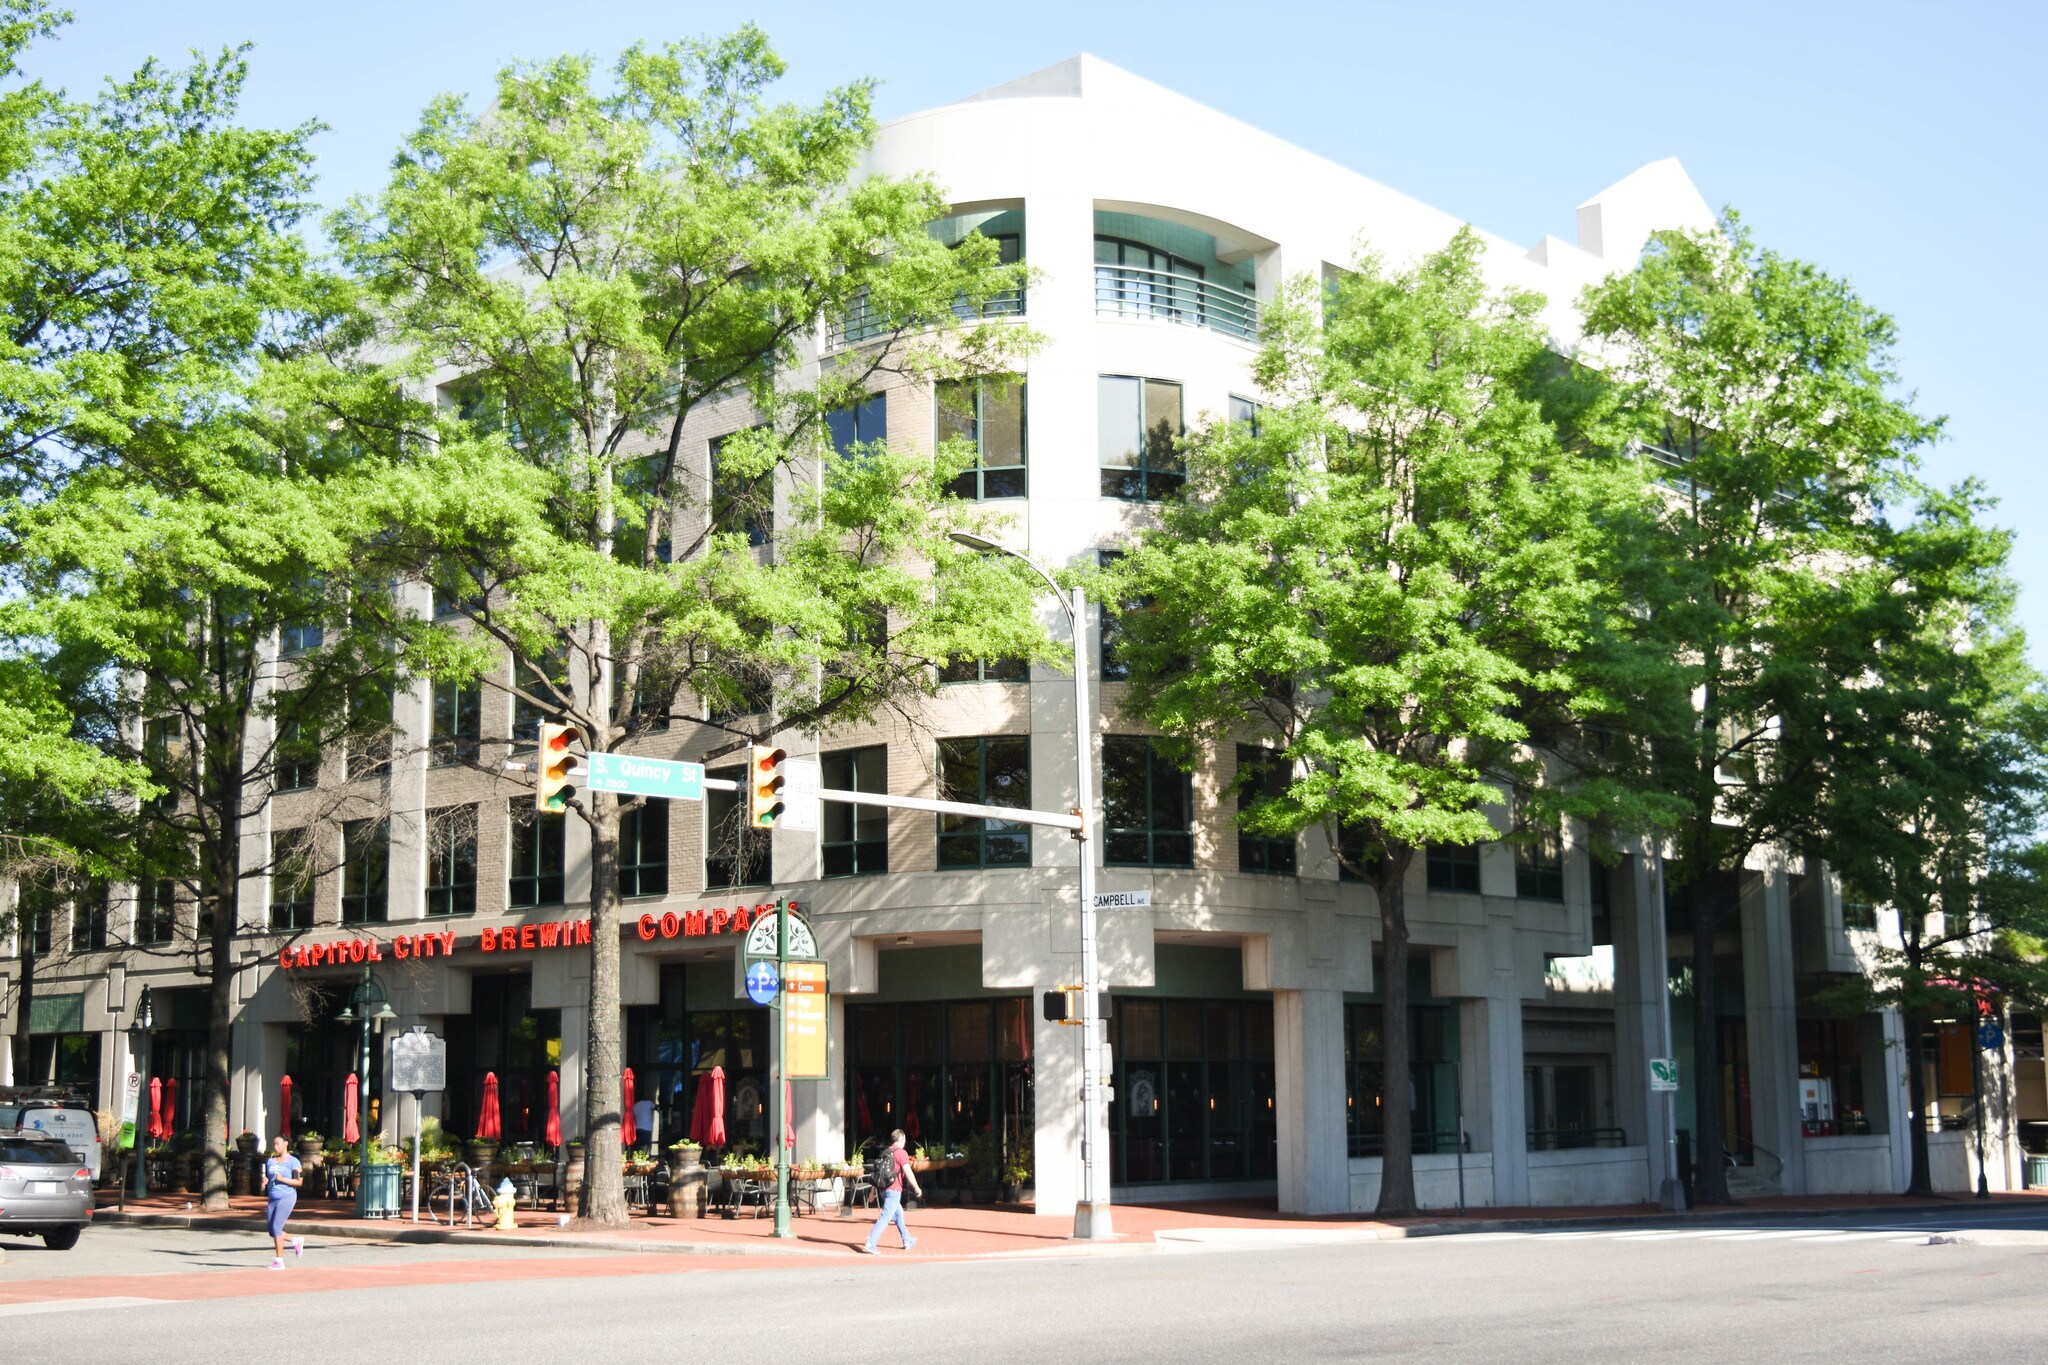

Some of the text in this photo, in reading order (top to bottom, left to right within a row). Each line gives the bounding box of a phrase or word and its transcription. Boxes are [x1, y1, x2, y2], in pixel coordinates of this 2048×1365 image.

[595, 757, 698, 783] S. Quincy St
[788, 782, 815, 794] YIELD
[1094, 894, 1135, 907] CAMPBELL
[279, 938, 382, 969] CAPITOL
[394, 931, 456, 959] CITY
[481, 919, 591, 951] BREWIN
[757, 972, 770, 993] P
